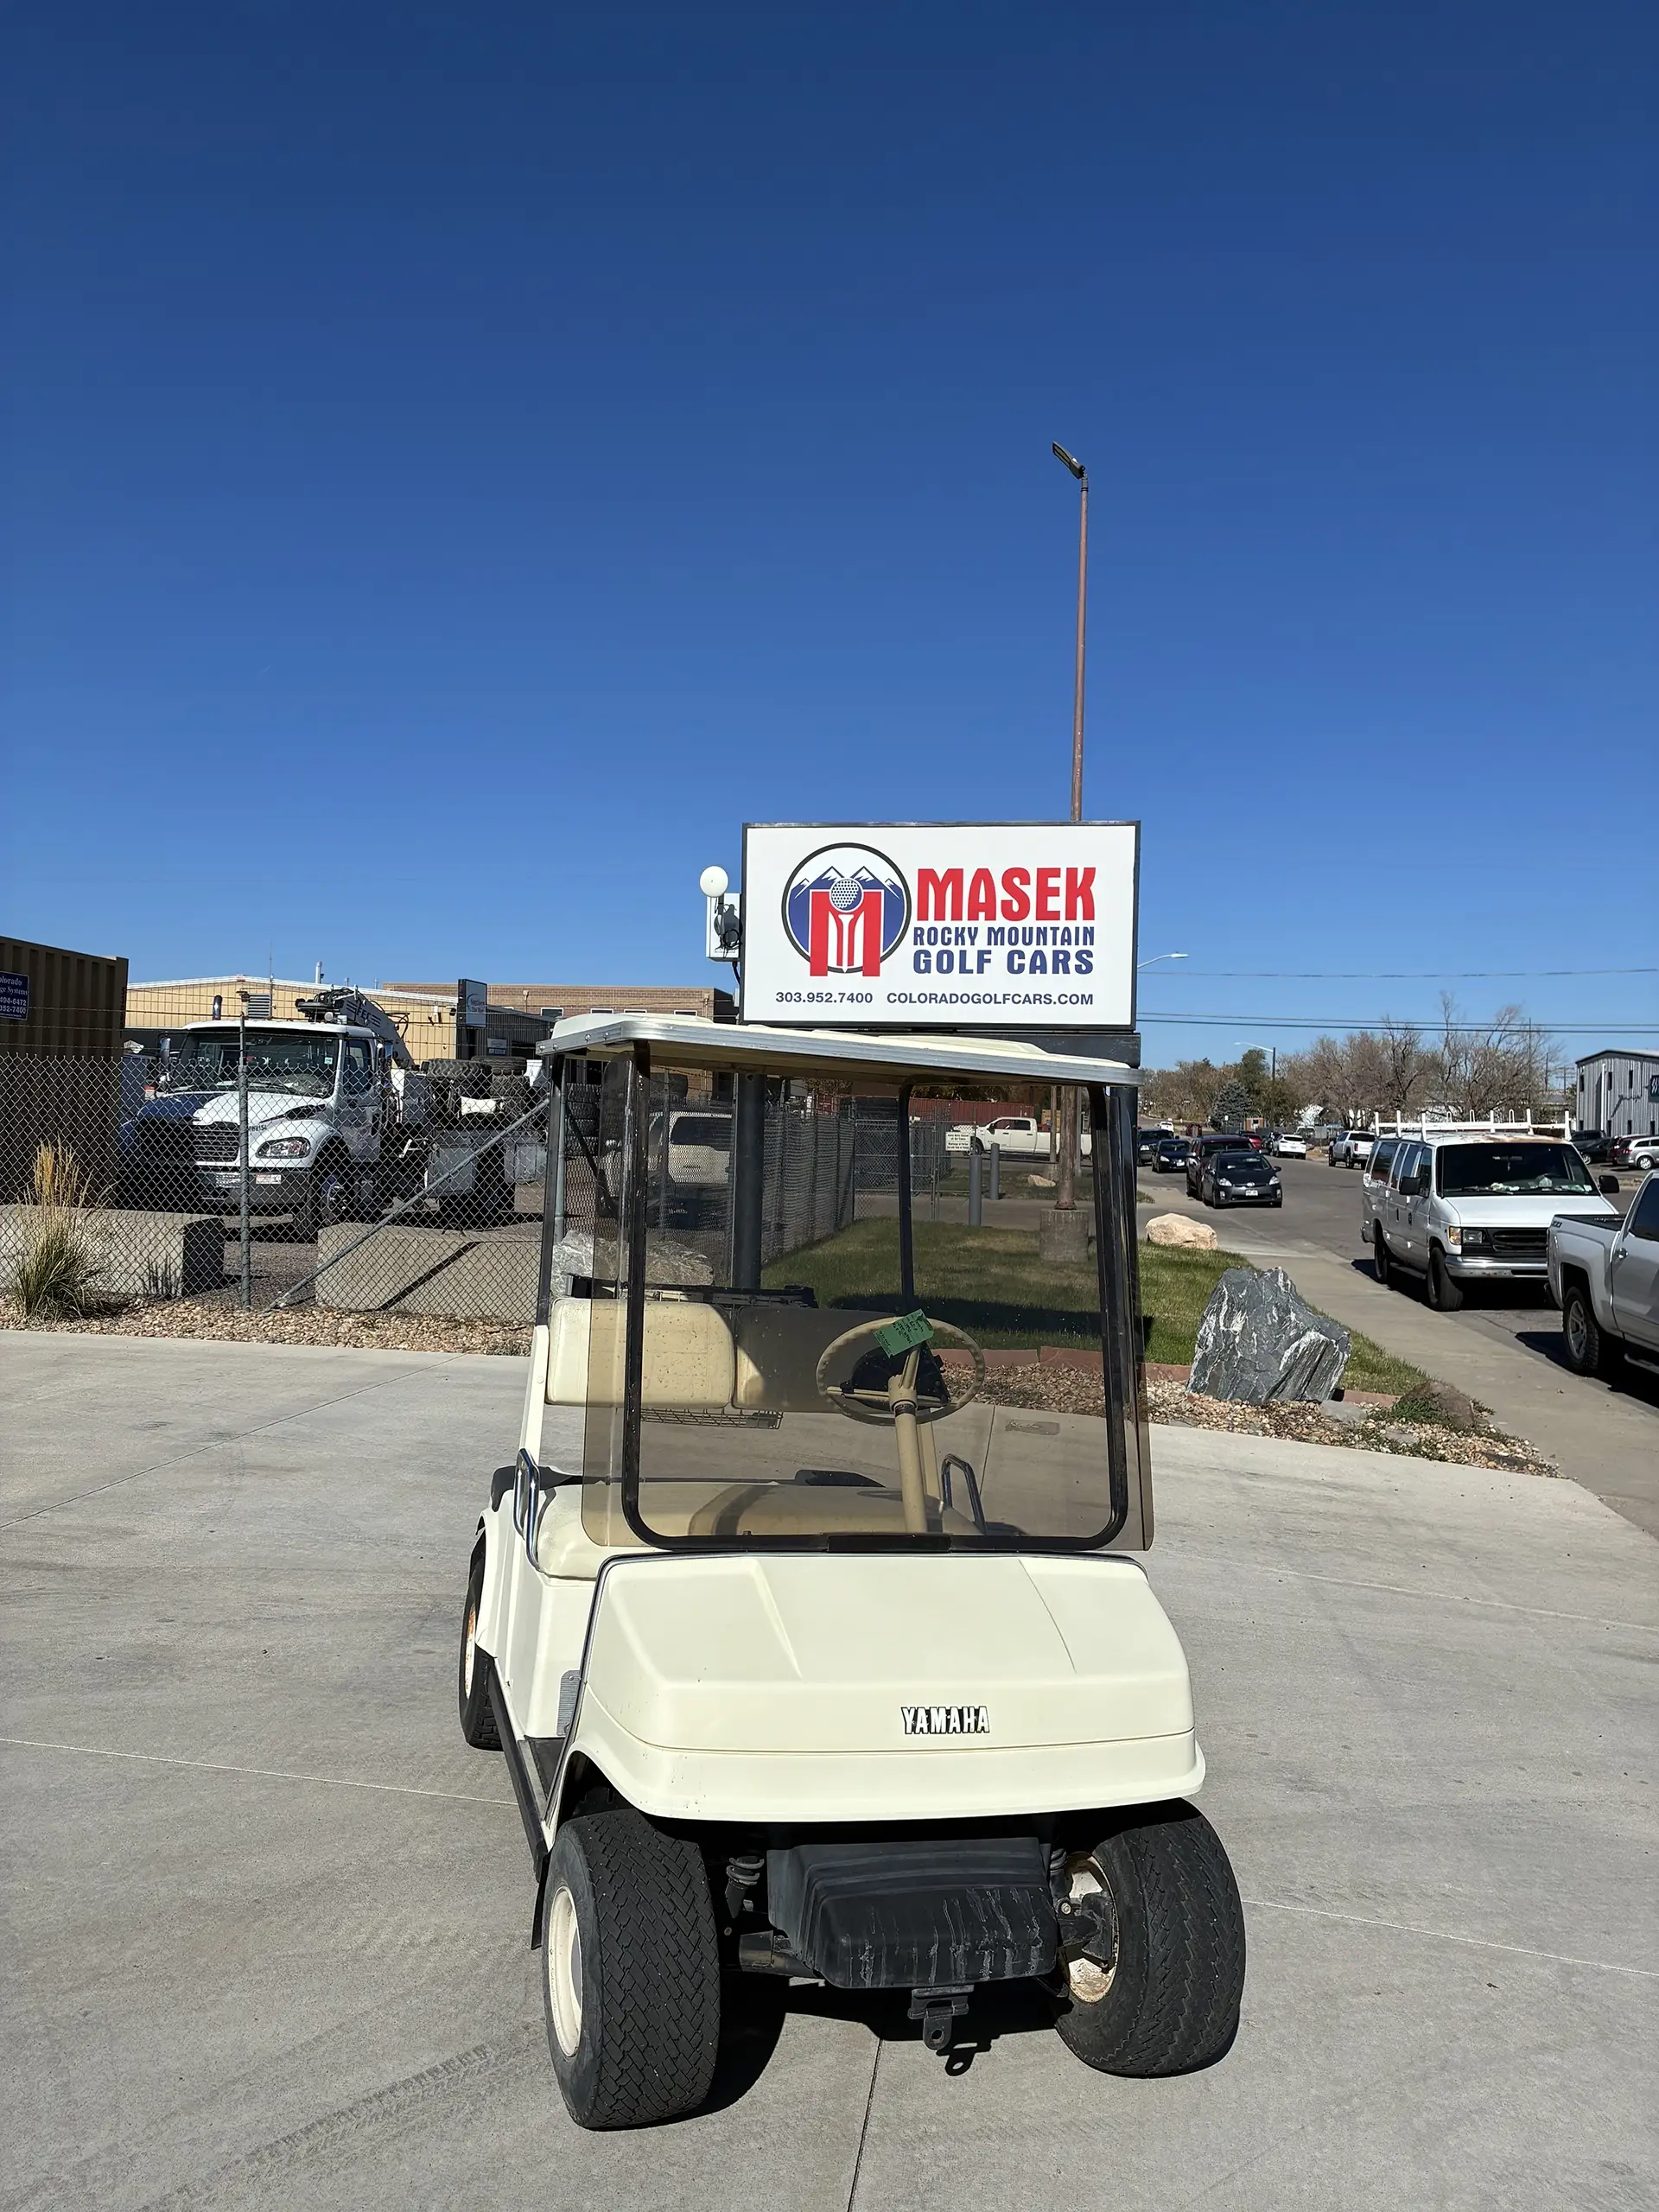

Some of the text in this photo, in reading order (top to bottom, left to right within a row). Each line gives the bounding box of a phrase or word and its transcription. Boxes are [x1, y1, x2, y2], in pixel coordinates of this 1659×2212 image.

[917, 867, 1096, 922] MASEK
[913, 926, 1095, 946] ROCKY MOUNTAIN
[913, 950, 1094, 975] GOLF CARS
[775, 992, 1094, 1005] 303.952.7400 COLORADOGOLFCARS.COM
[900, 1706, 990, 1735] YAMAHA
